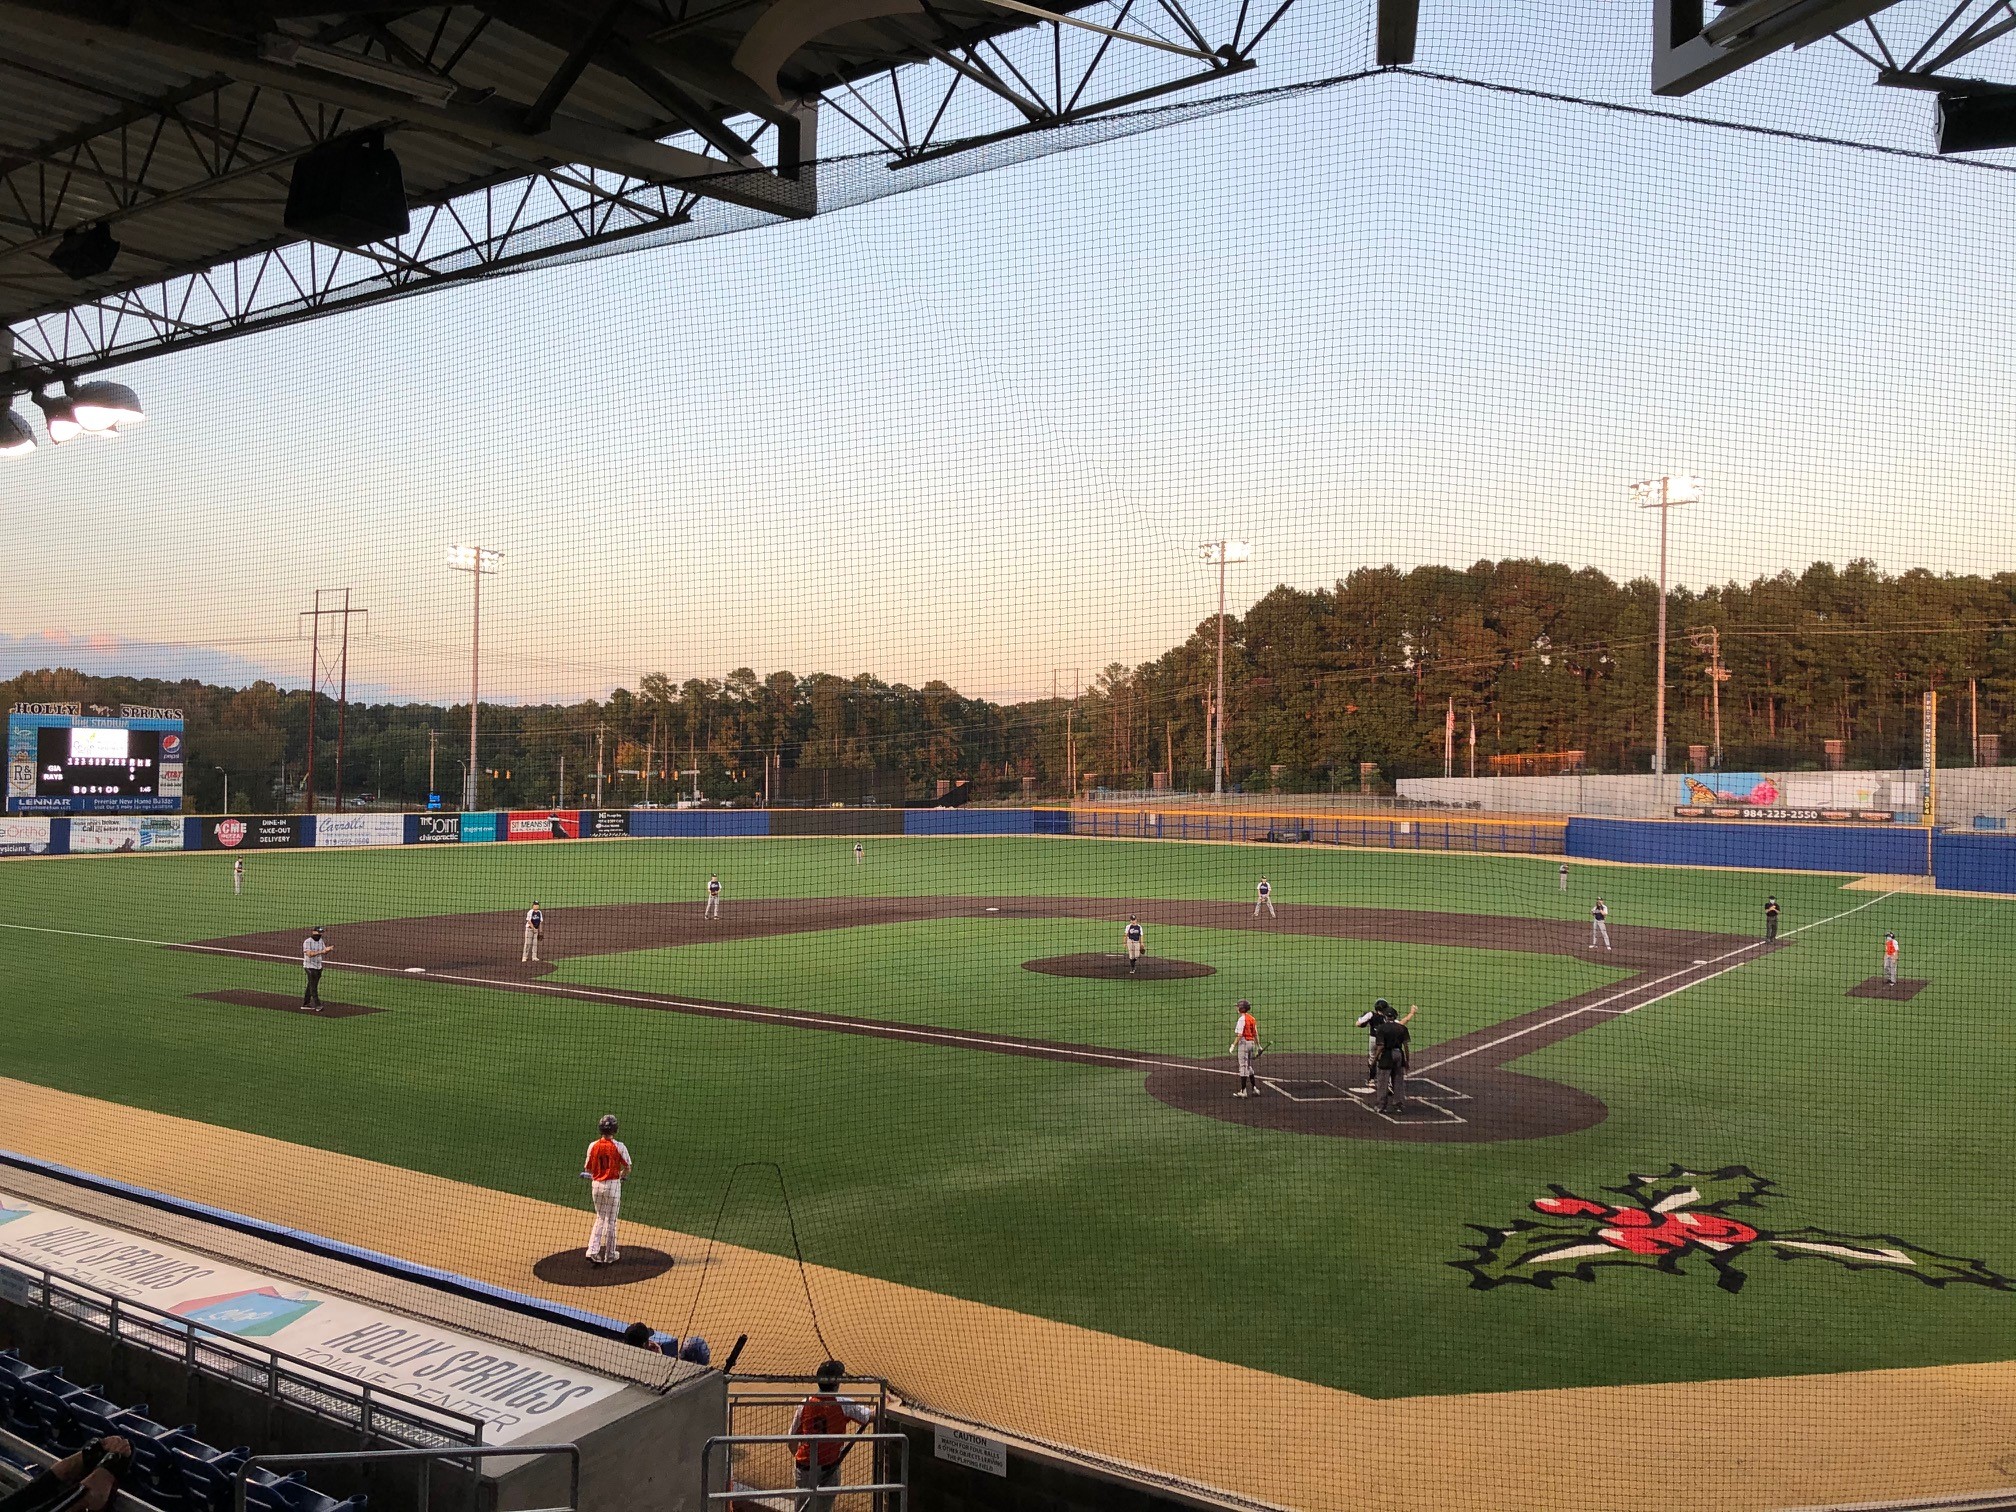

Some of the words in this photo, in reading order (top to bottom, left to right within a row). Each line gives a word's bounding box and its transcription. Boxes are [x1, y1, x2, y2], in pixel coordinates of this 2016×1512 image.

[15, 702, 78, 715] HOLLY
[121, 706, 183, 720] SPRINGS
[92, 718, 130, 728] STADIUM
[43, 773, 64, 781] RAYS
[18, 798, 72, 806] LENNAR
[420, 816, 433, 826] THE
[1742, 809, 1818, 819] 984-225-2550
[213, 822, 247, 835] ACME
[521, 819, 543, 829] MEANS
[418, 833, 459, 841] chiropractic
[16, 1226, 121, 1258] HOLLY
[76, 1245, 214, 1290] SPRINGS
[321, 1322, 456, 1369] HOLLY
[412, 1350, 594, 1415] SPRINGS
[297, 1347, 398, 1384] TOWNE
[392, 1382, 521, 1433] CENTER
[953, 1430, 987, 1447] CAUTION
[941, 1438, 959, 1448] WATCH
[969, 1445, 983, 1455] FOUL
[984, 1450, 1000, 1460] BALLS
[942, 1445, 958, 1455] OTHER
[959, 1450, 981, 1461] OBJECTS
[981, 1456, 1003, 1468] LEAVING
[957, 1456, 979, 1468] PLAYING
[979, 1463, 994, 1472] FIELD
